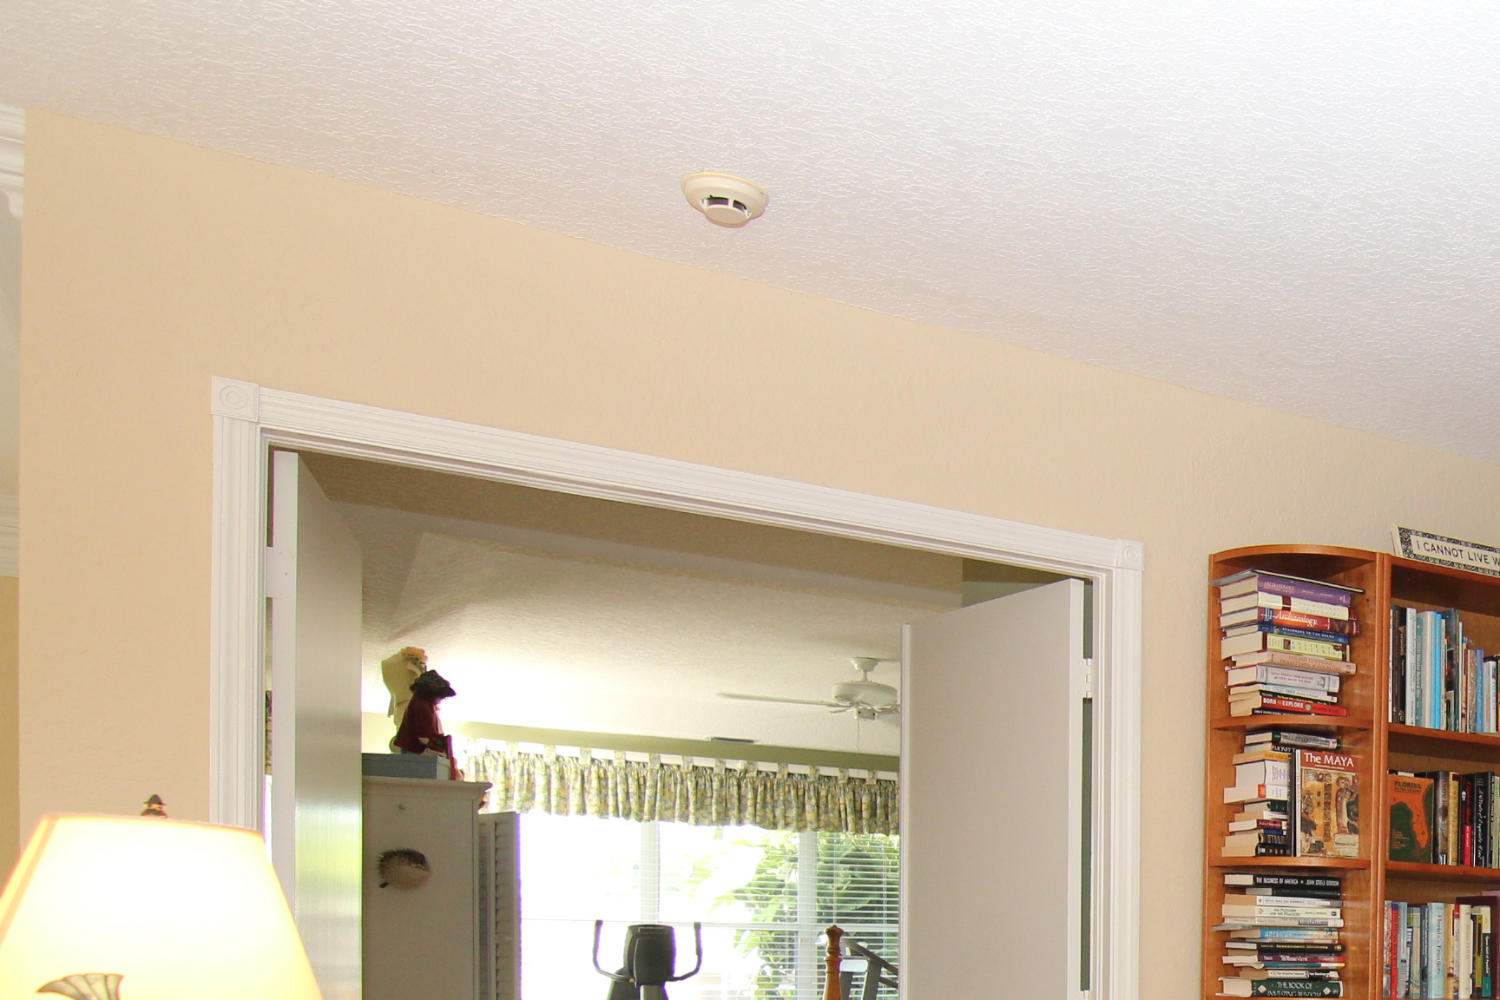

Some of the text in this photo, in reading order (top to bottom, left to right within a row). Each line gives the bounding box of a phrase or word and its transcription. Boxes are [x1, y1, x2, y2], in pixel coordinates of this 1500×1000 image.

[1416, 541, 1420, 550] I
[1424, 542, 1464, 559] CANNOT
[1468, 552, 1489, 564] LIVE
[1304, 752, 1354, 767] The MAYA
